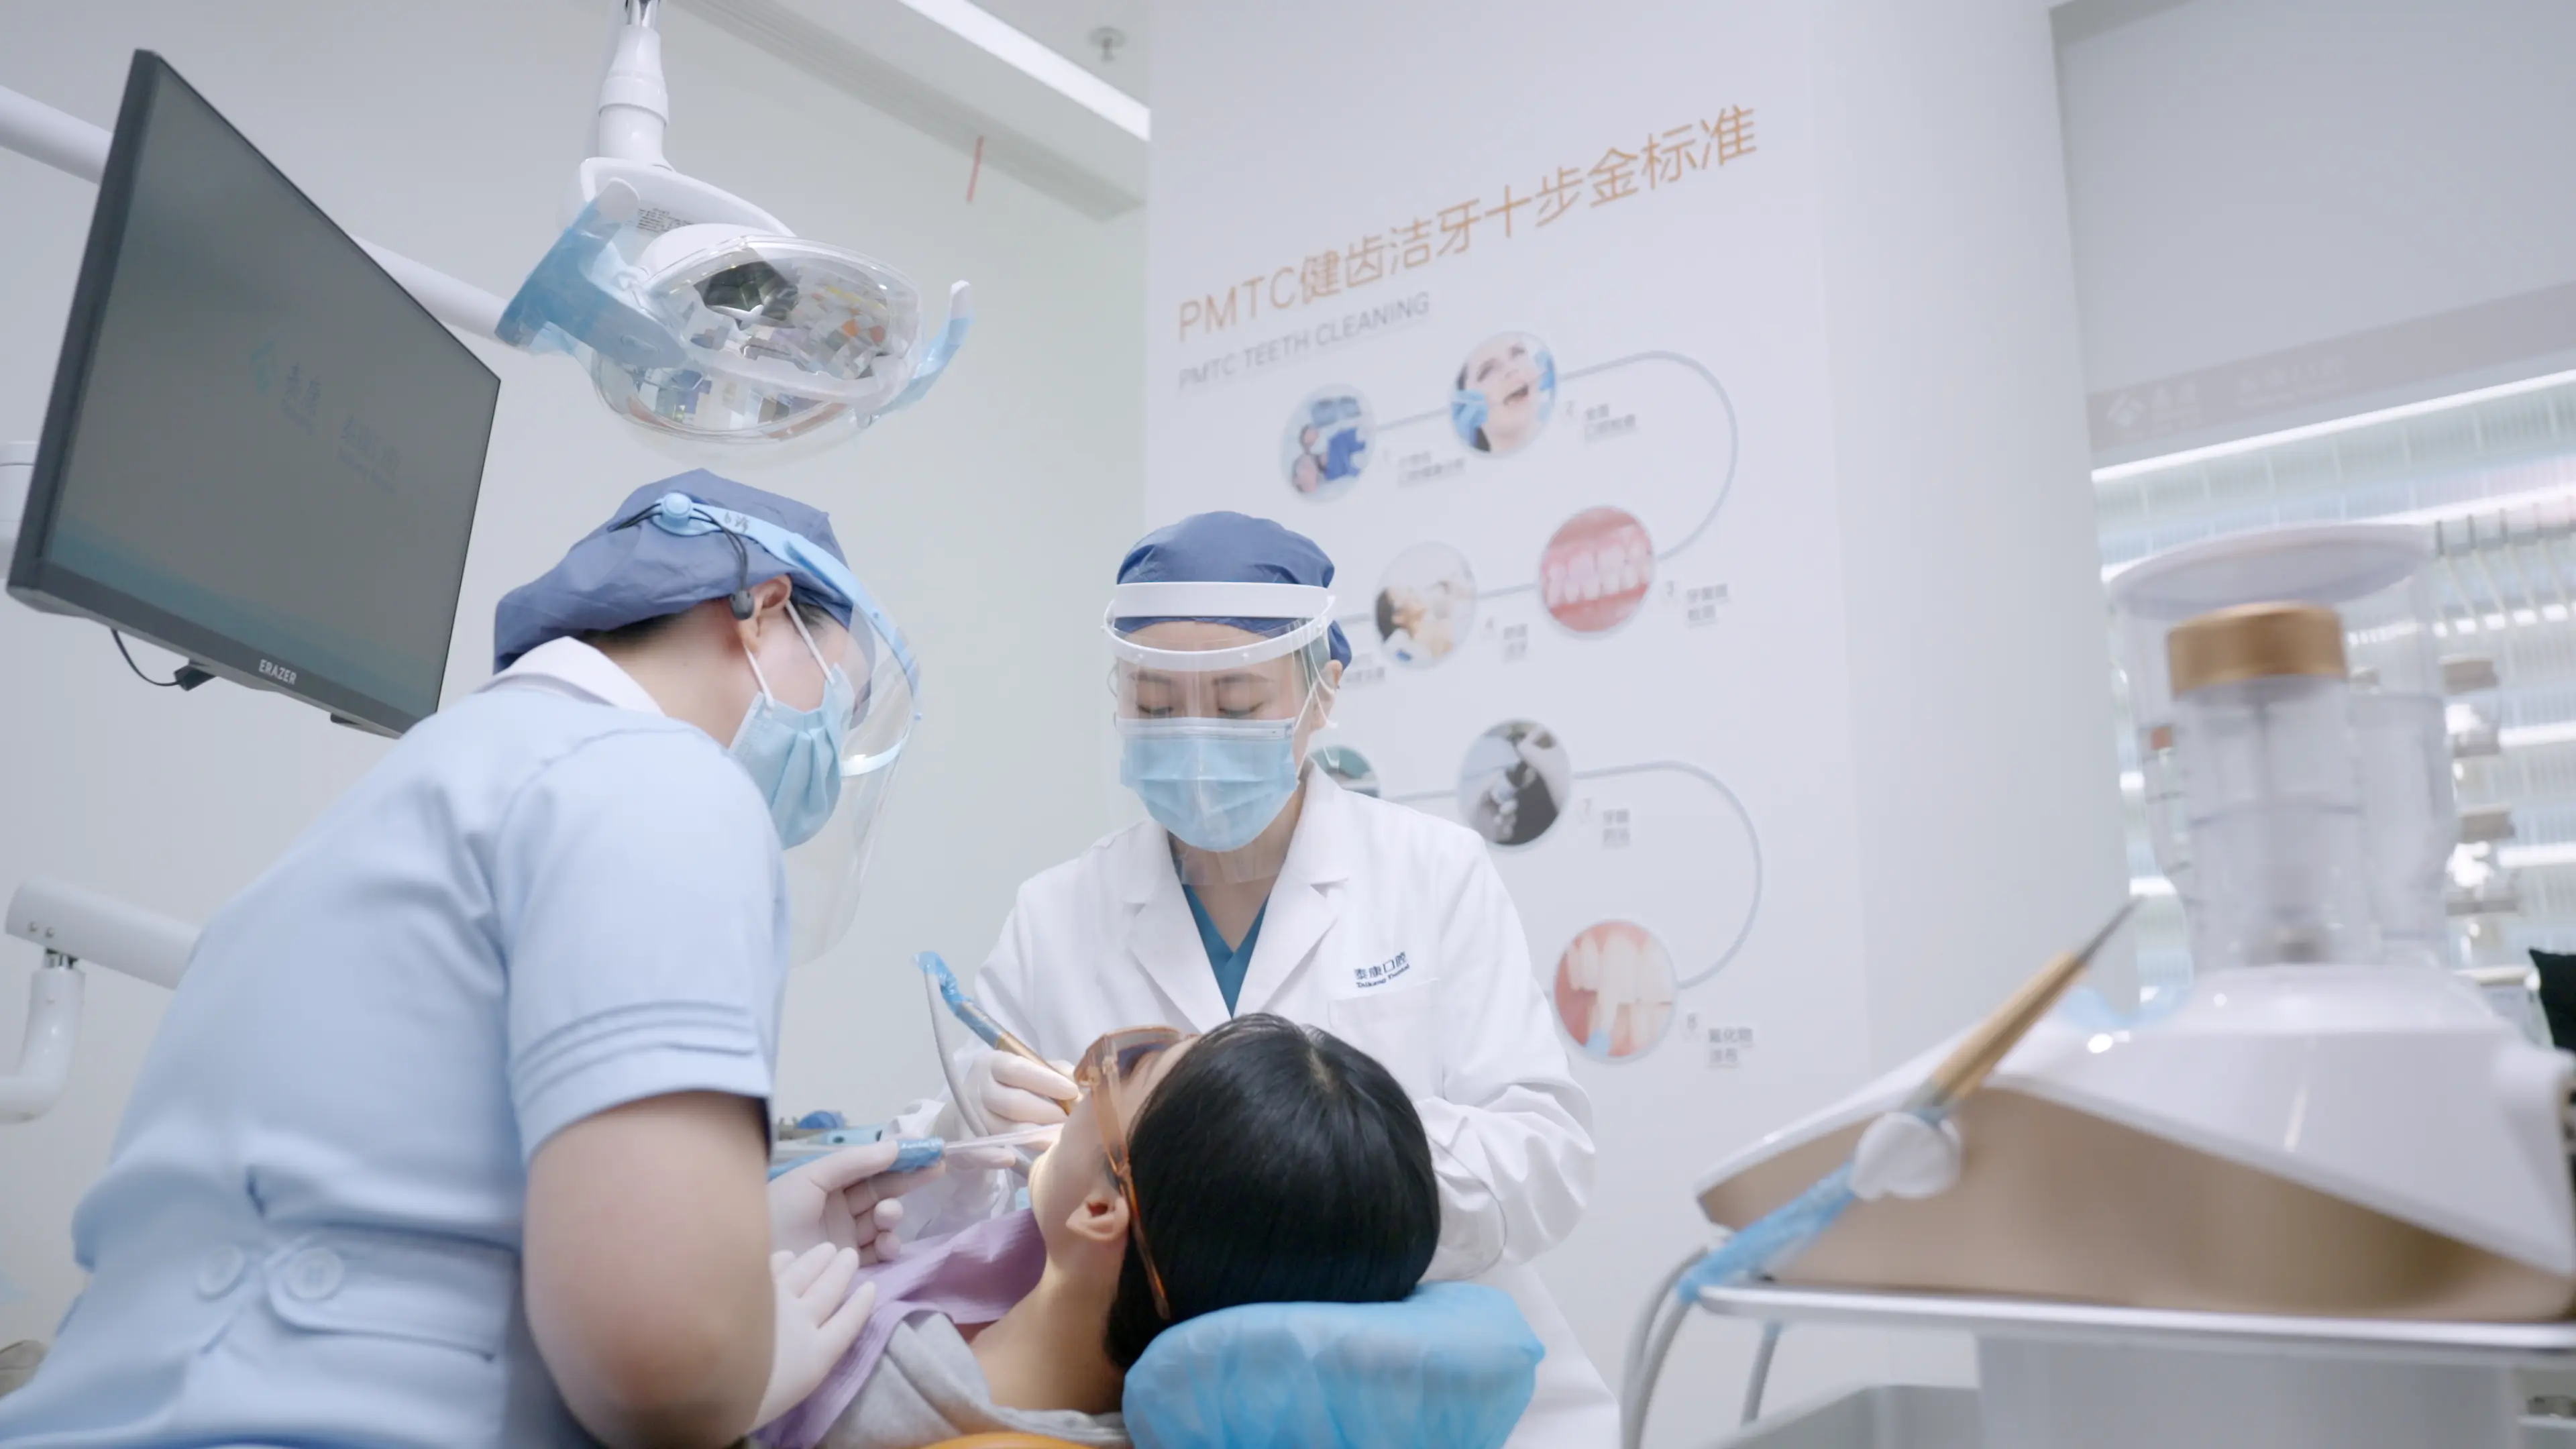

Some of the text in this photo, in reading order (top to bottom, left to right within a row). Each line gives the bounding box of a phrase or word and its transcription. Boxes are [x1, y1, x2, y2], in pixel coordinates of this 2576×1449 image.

[1179, 104, 1758, 343] PMTC健齿洁牙十步金标准
[1179, 291, 1430, 390] PMTC TEETH CLEANING
[258, 659, 297, 685] ERAZER
